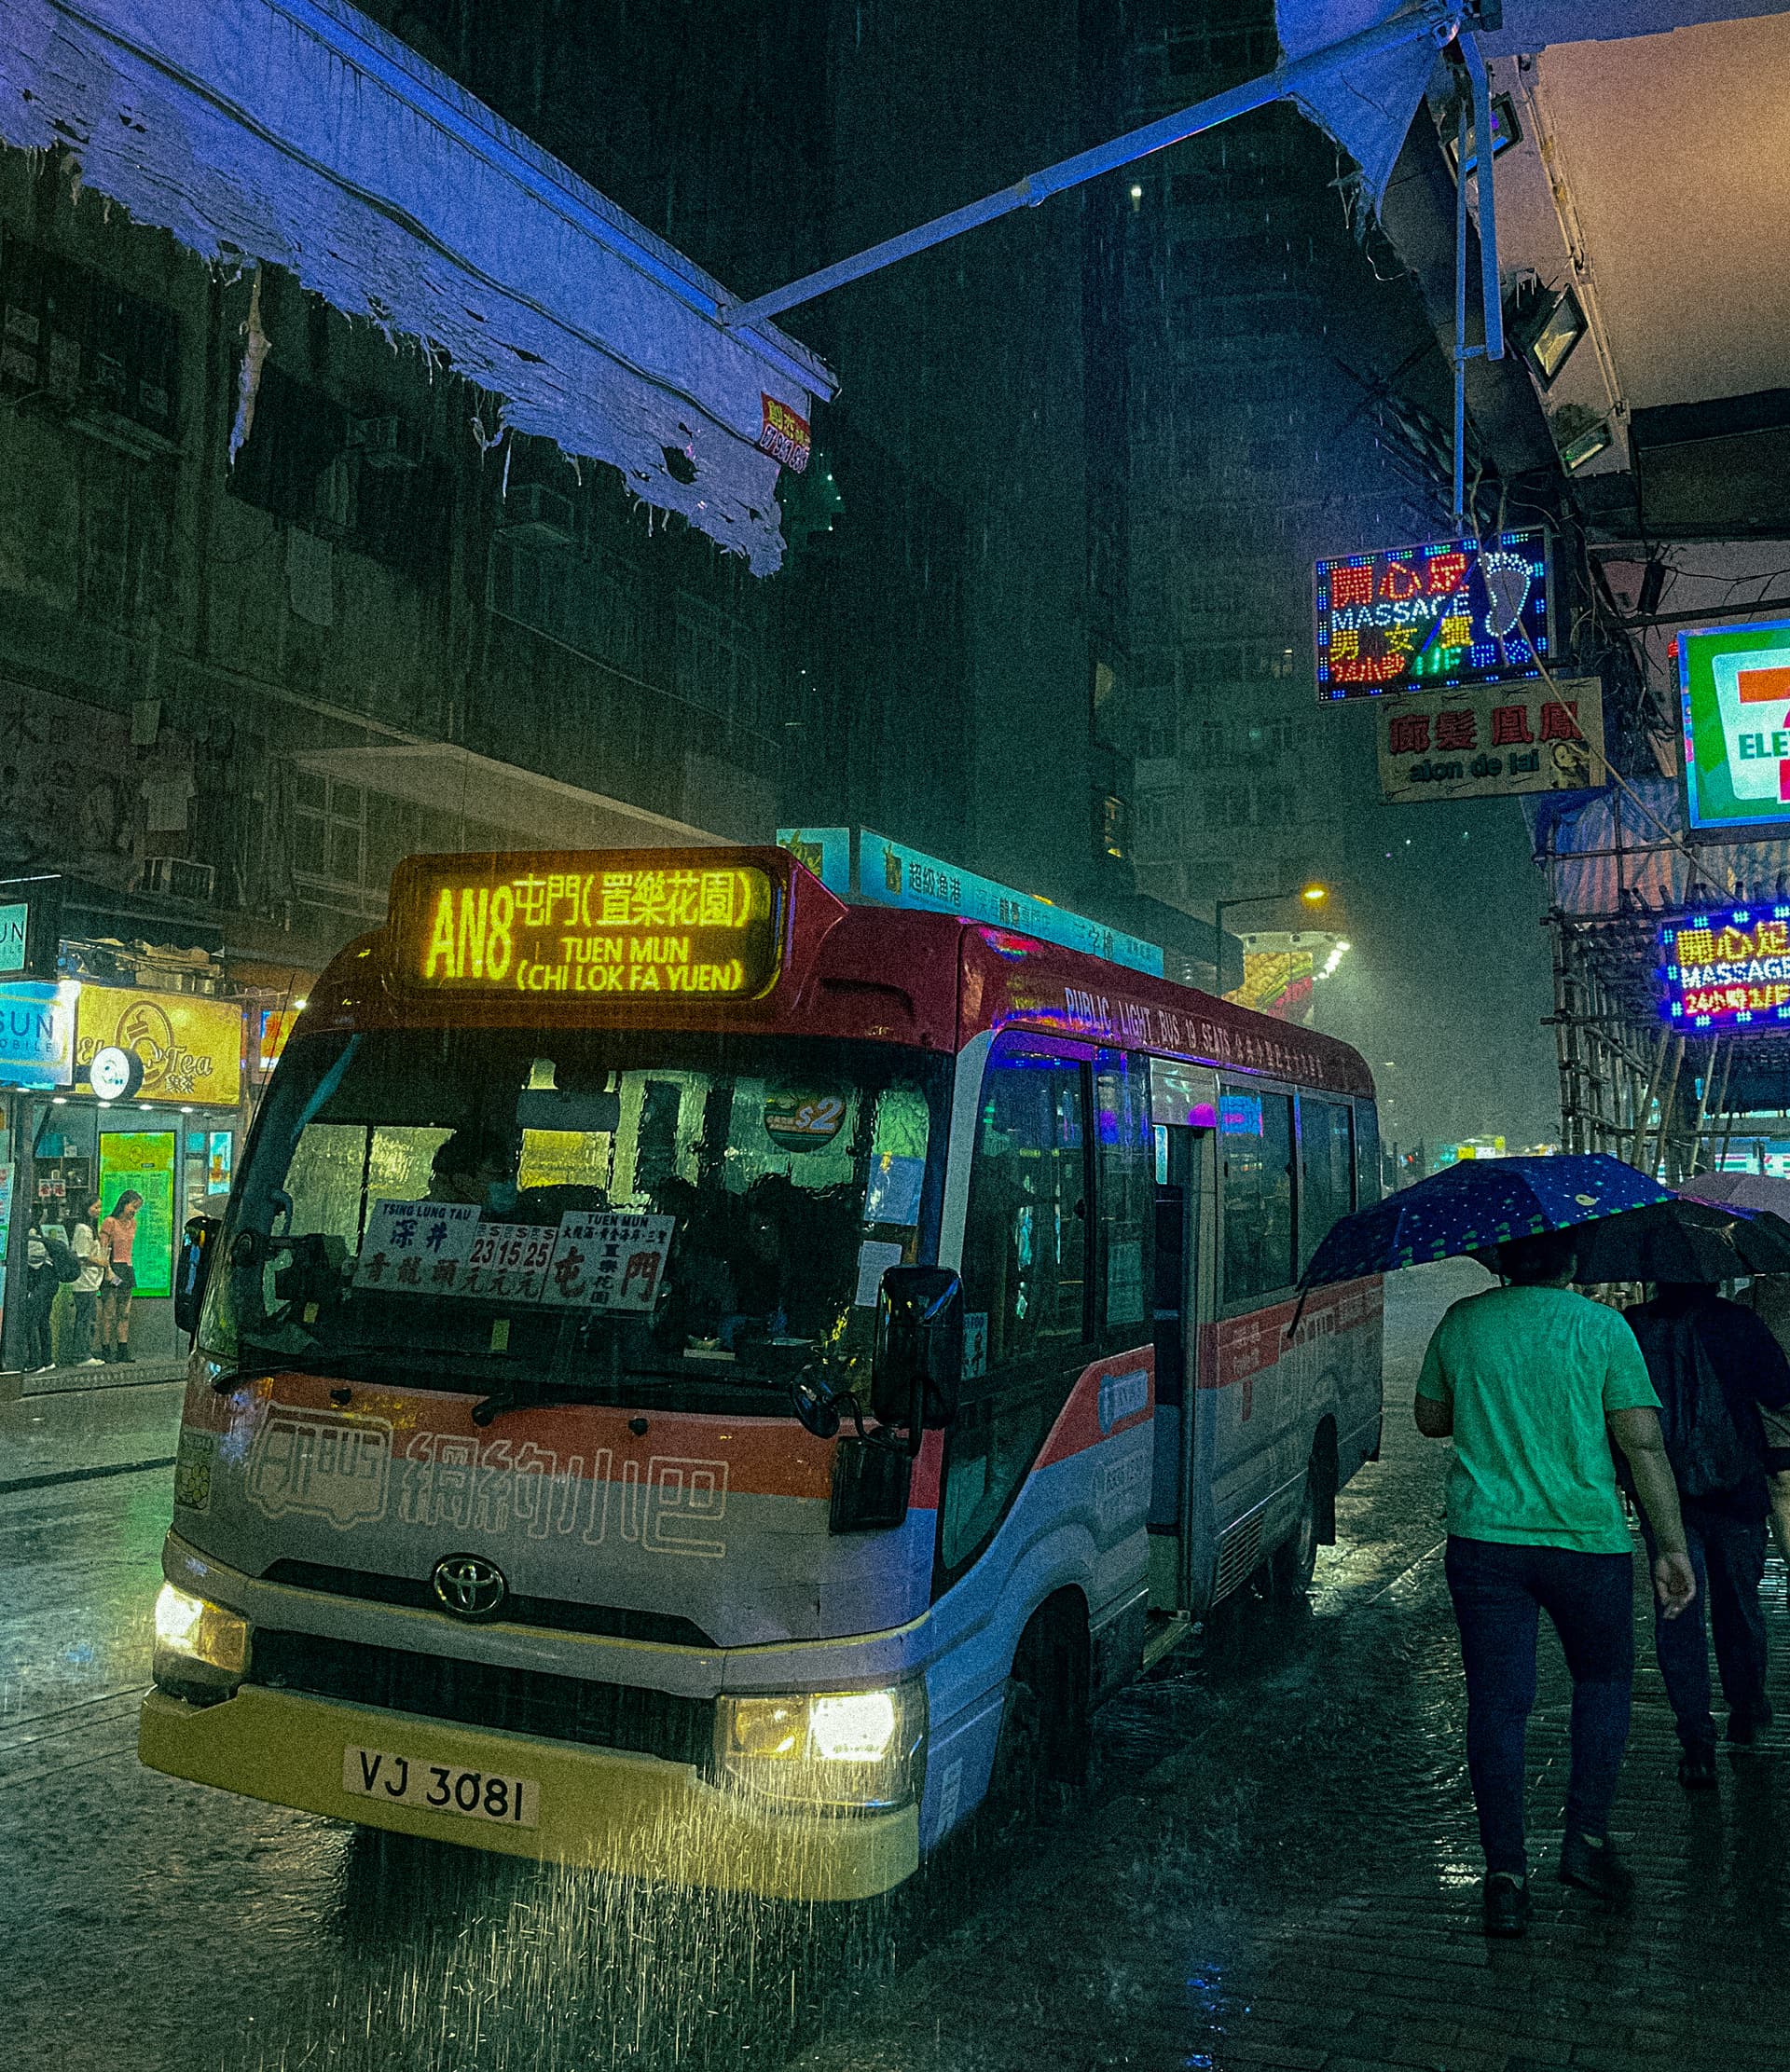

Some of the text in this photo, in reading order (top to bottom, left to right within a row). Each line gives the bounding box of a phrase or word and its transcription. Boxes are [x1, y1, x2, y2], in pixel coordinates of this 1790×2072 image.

[1739, 730, 1790, 761] ELE
[514, 871, 752, 928] 屯門(置樂花園)
[425, 887, 514, 981] AN8
[561, 936, 689, 964] TUEN MUN
[516, 959, 745, 992] (CHI LOK FA YUEN)
[1065, 986, 1114, 1031] PUBLIC
[1118, 1000, 1152, 1045] LIGHT
[1160, 1010, 1180, 1046] BUS
[1201, 1022, 1232, 1056] SEATS
[165, 1046, 213, 1076] Tea
[383, 1203, 472, 1220] TSING LUNG TAU
[587, 1214, 649, 1228] TUEN MUN
[469, 1239, 550, 1268] 23 15 25
[360, 1750, 523, 1821] VJ 3081
